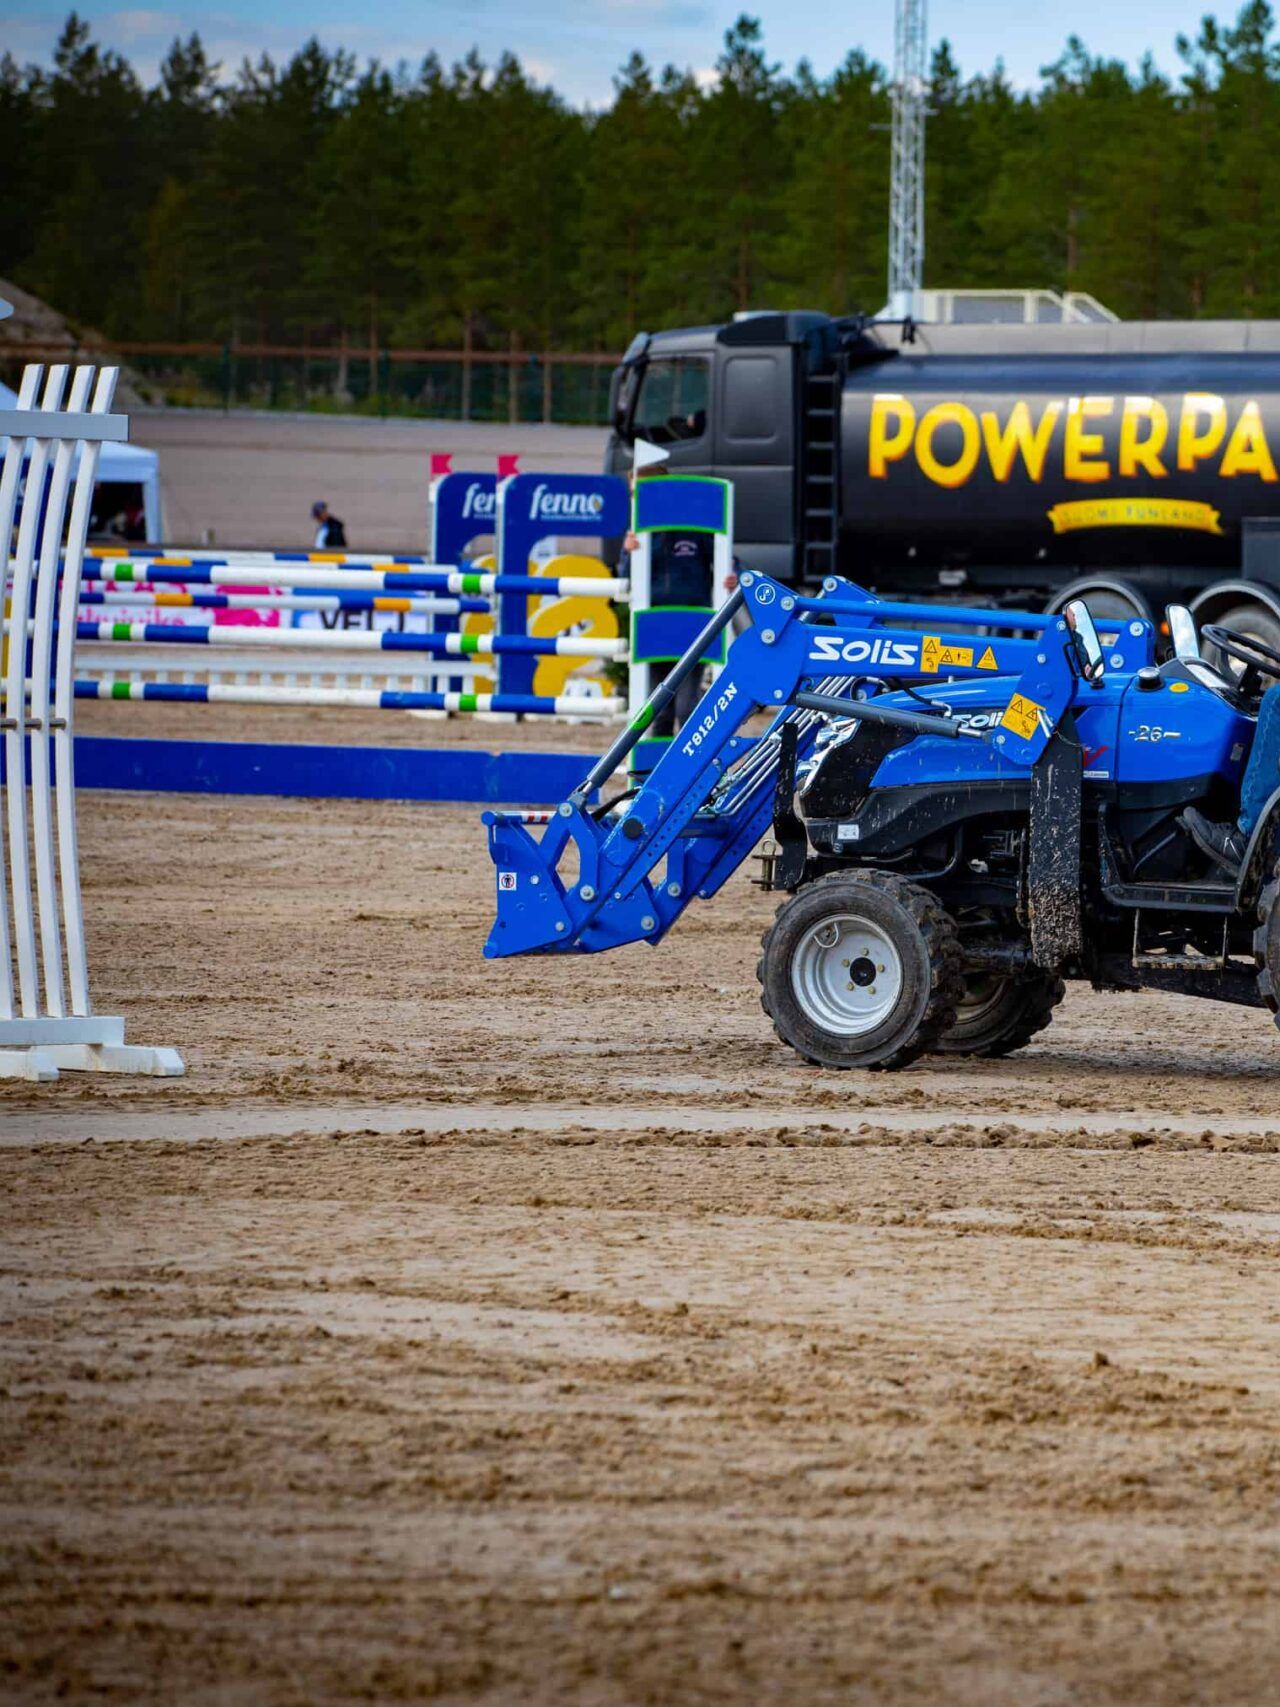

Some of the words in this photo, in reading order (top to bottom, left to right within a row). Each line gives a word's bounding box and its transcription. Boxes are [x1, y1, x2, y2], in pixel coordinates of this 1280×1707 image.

[529, 483, 603, 520] fenno
[682, 681, 737, 756] T812/2N
[951, 712, 1003, 728] Soli
